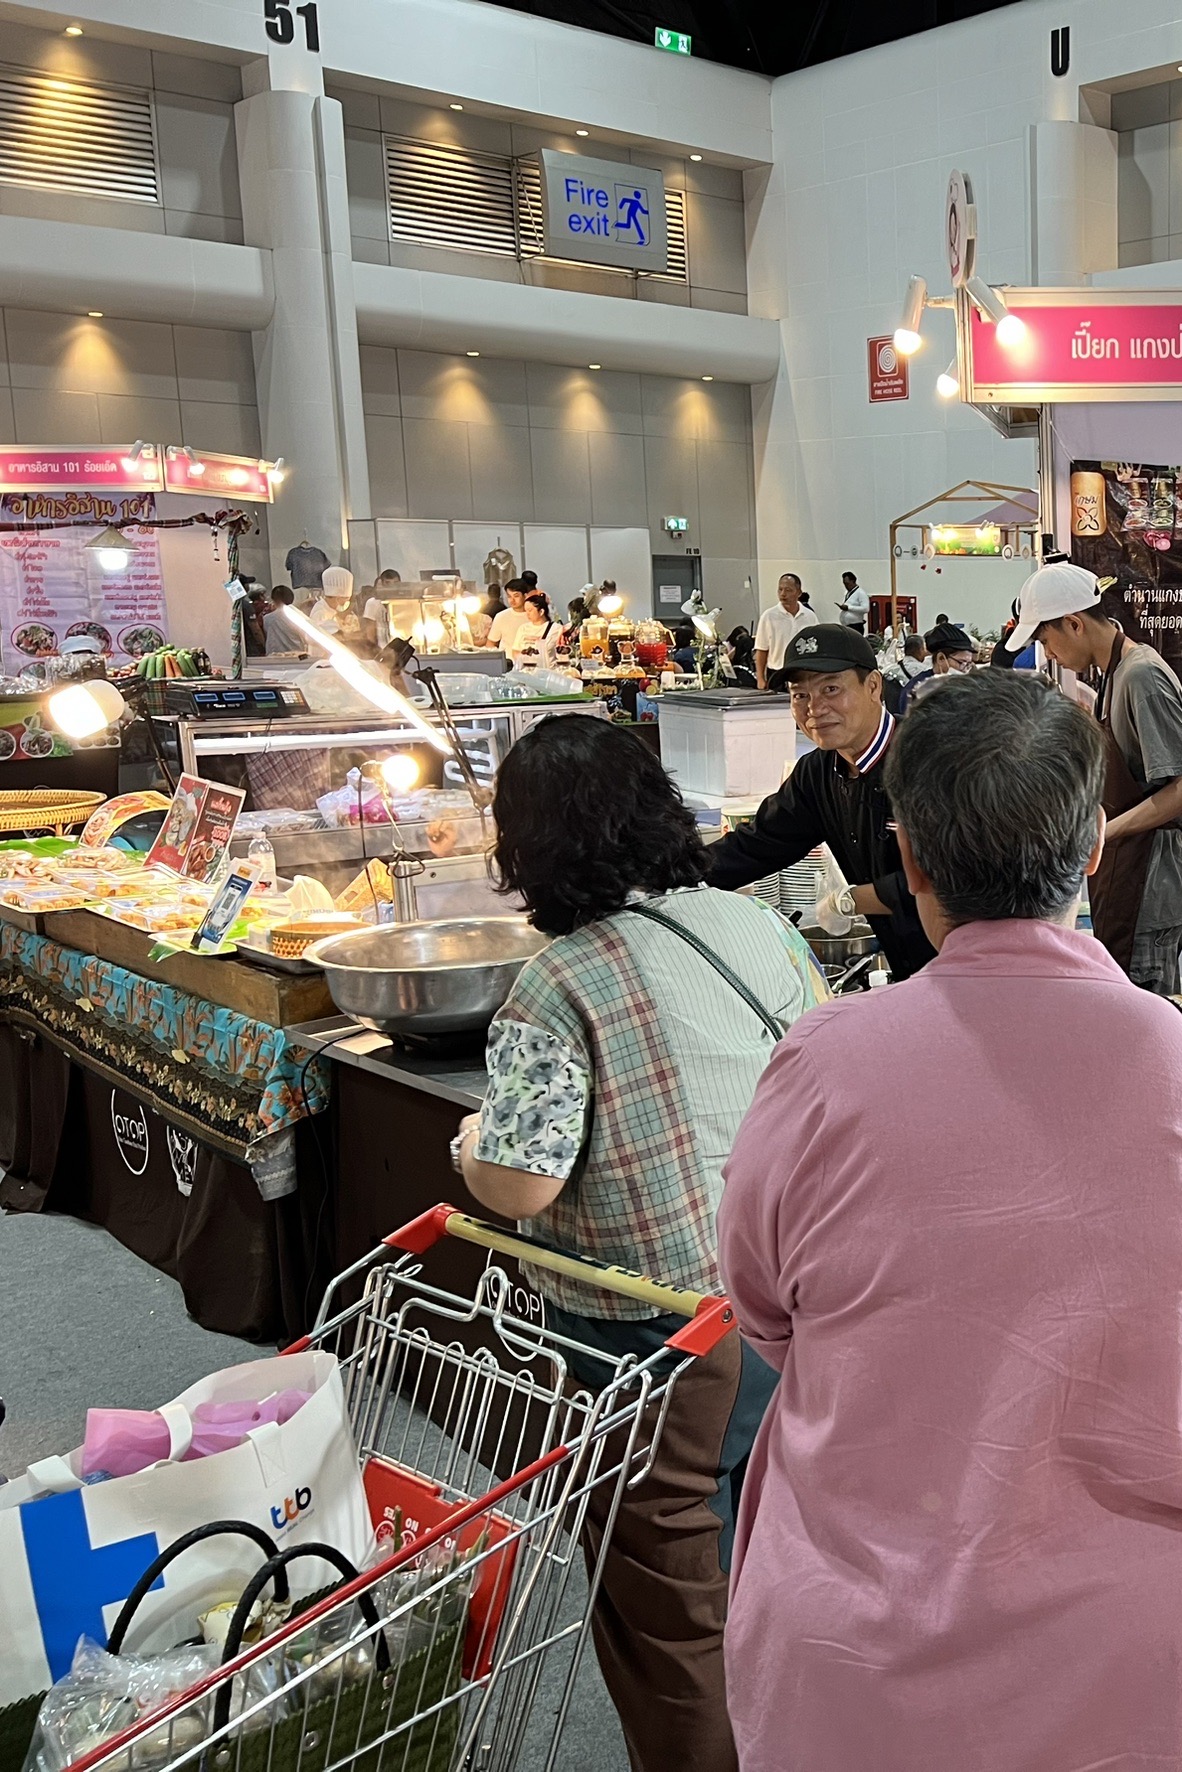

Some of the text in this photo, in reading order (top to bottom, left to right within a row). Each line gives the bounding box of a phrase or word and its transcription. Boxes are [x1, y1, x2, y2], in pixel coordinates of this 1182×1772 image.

[264, 0, 319, 53] 51
[1051, 26, 1070, 76] U
[565, 178, 608, 208] Fire
[568, 212, 609, 236] exit
[1071, 321, 1120, 360] เปี๊ยก
[62, 462, 80, 473] 101
[119, 496, 151, 519] 101
[115, 1114, 145, 1142] OTOP
[270, 1486, 312, 1530] ttb
[383, 1506, 395, 1520] ES
